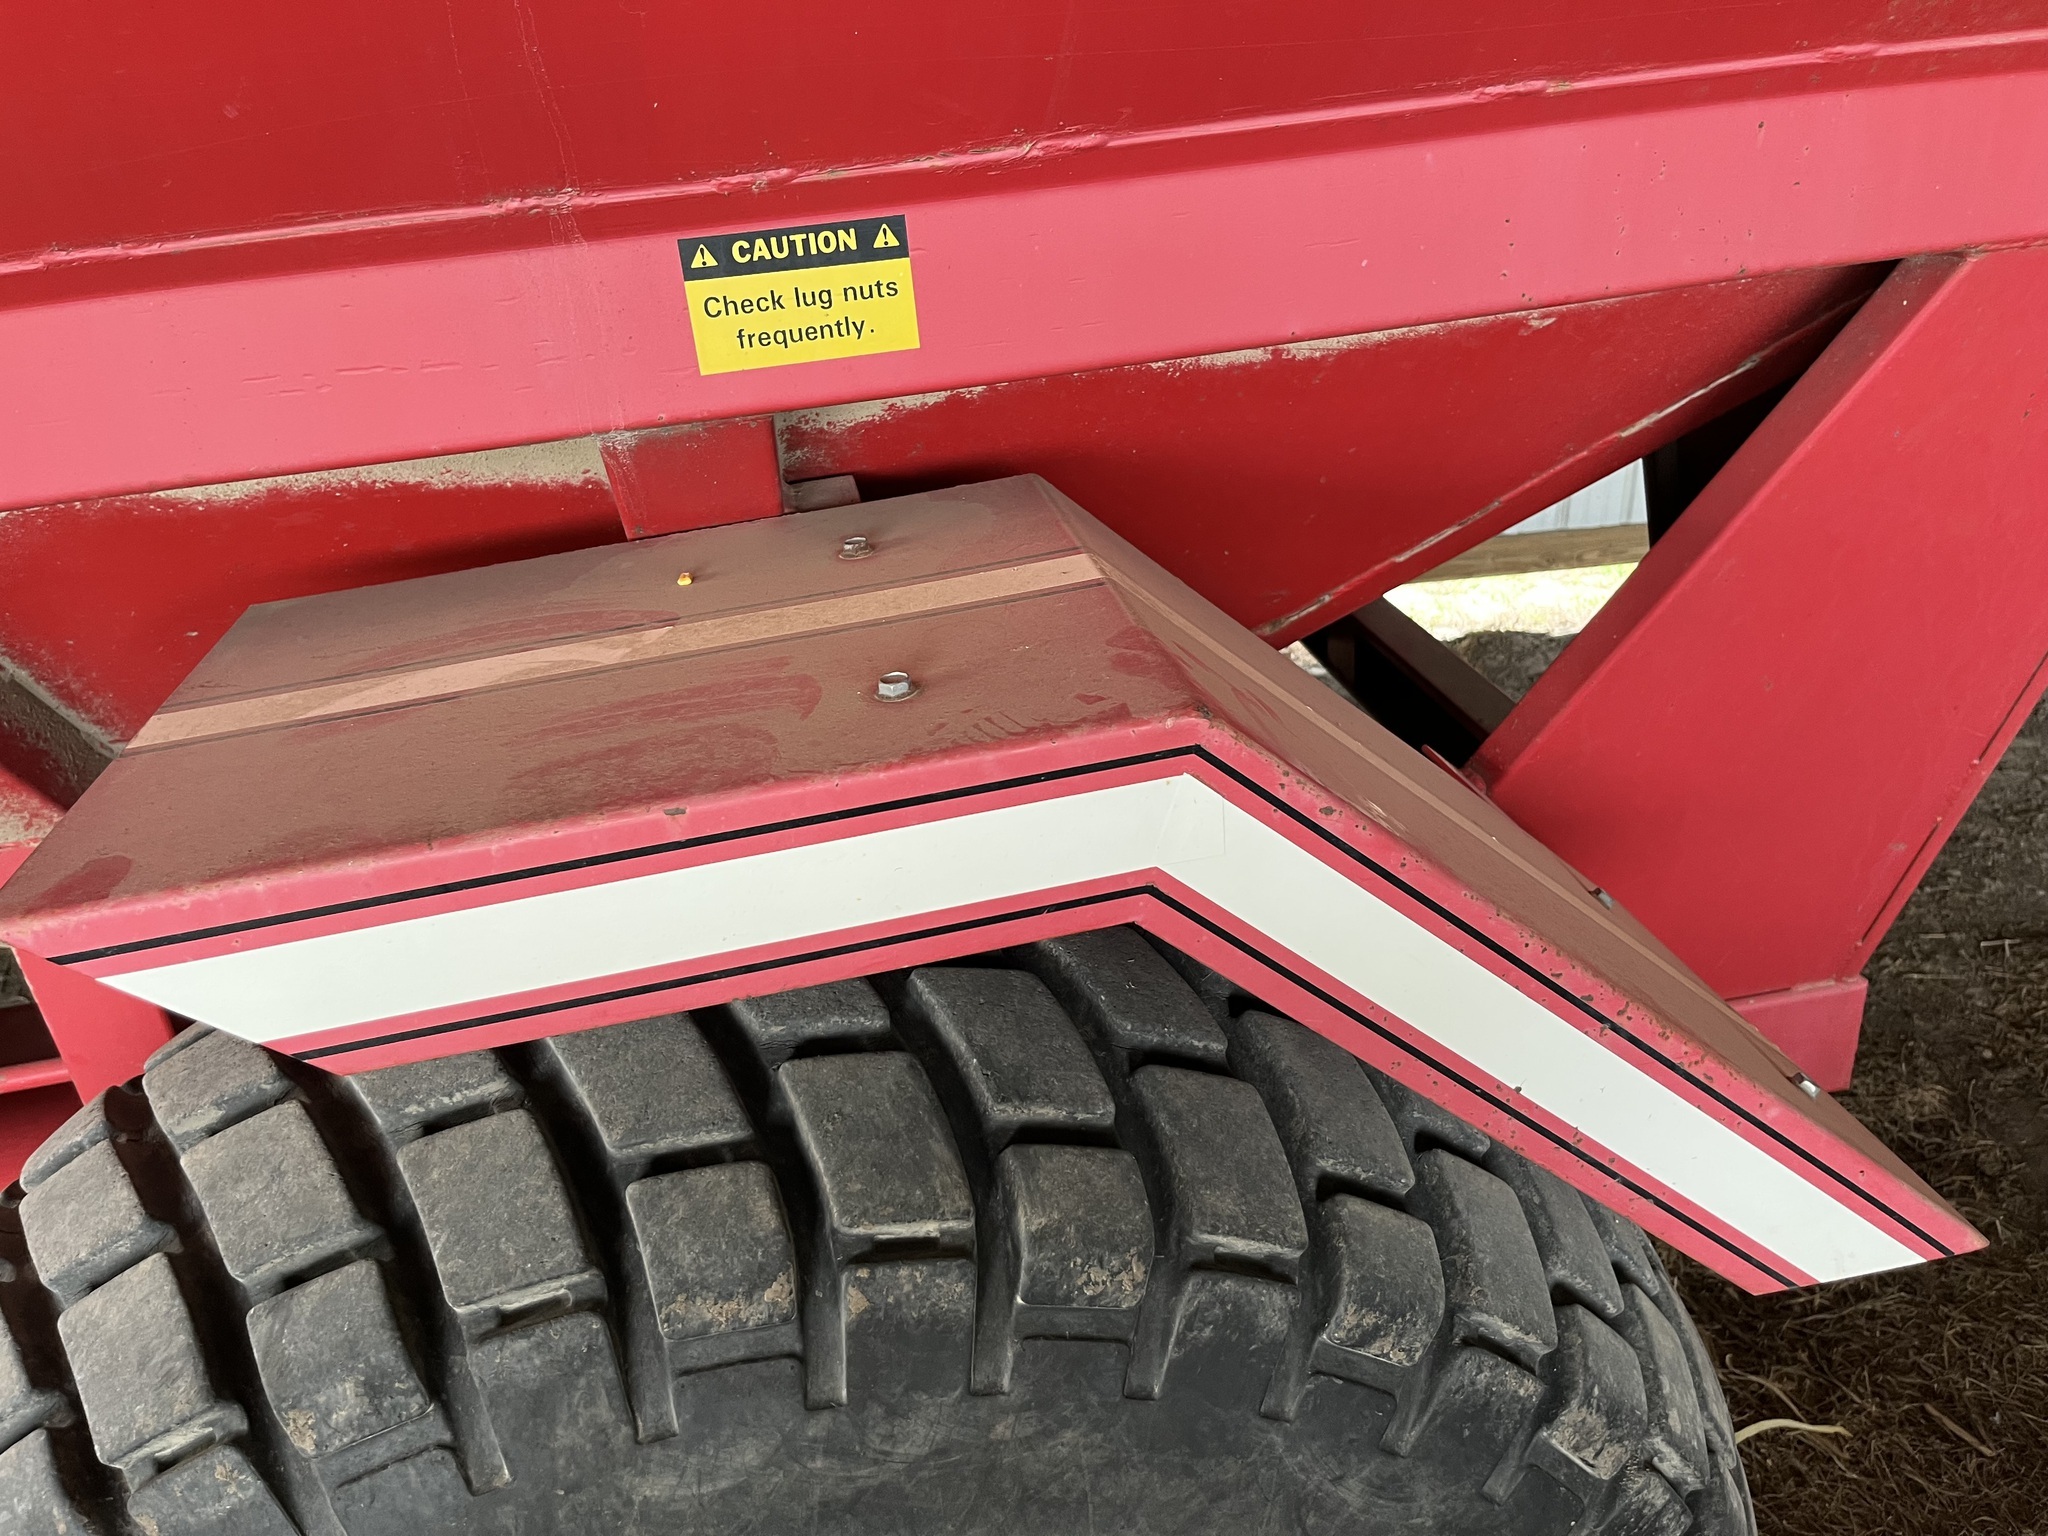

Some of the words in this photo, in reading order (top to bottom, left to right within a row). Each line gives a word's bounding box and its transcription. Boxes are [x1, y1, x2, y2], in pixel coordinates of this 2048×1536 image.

[731, 228, 858, 264] CAUTION
[704, 289, 786, 318] Check
[794, 287, 833, 310] lug
[843, 280, 899, 302] nuts
[736, 316, 875, 349] frequently.
